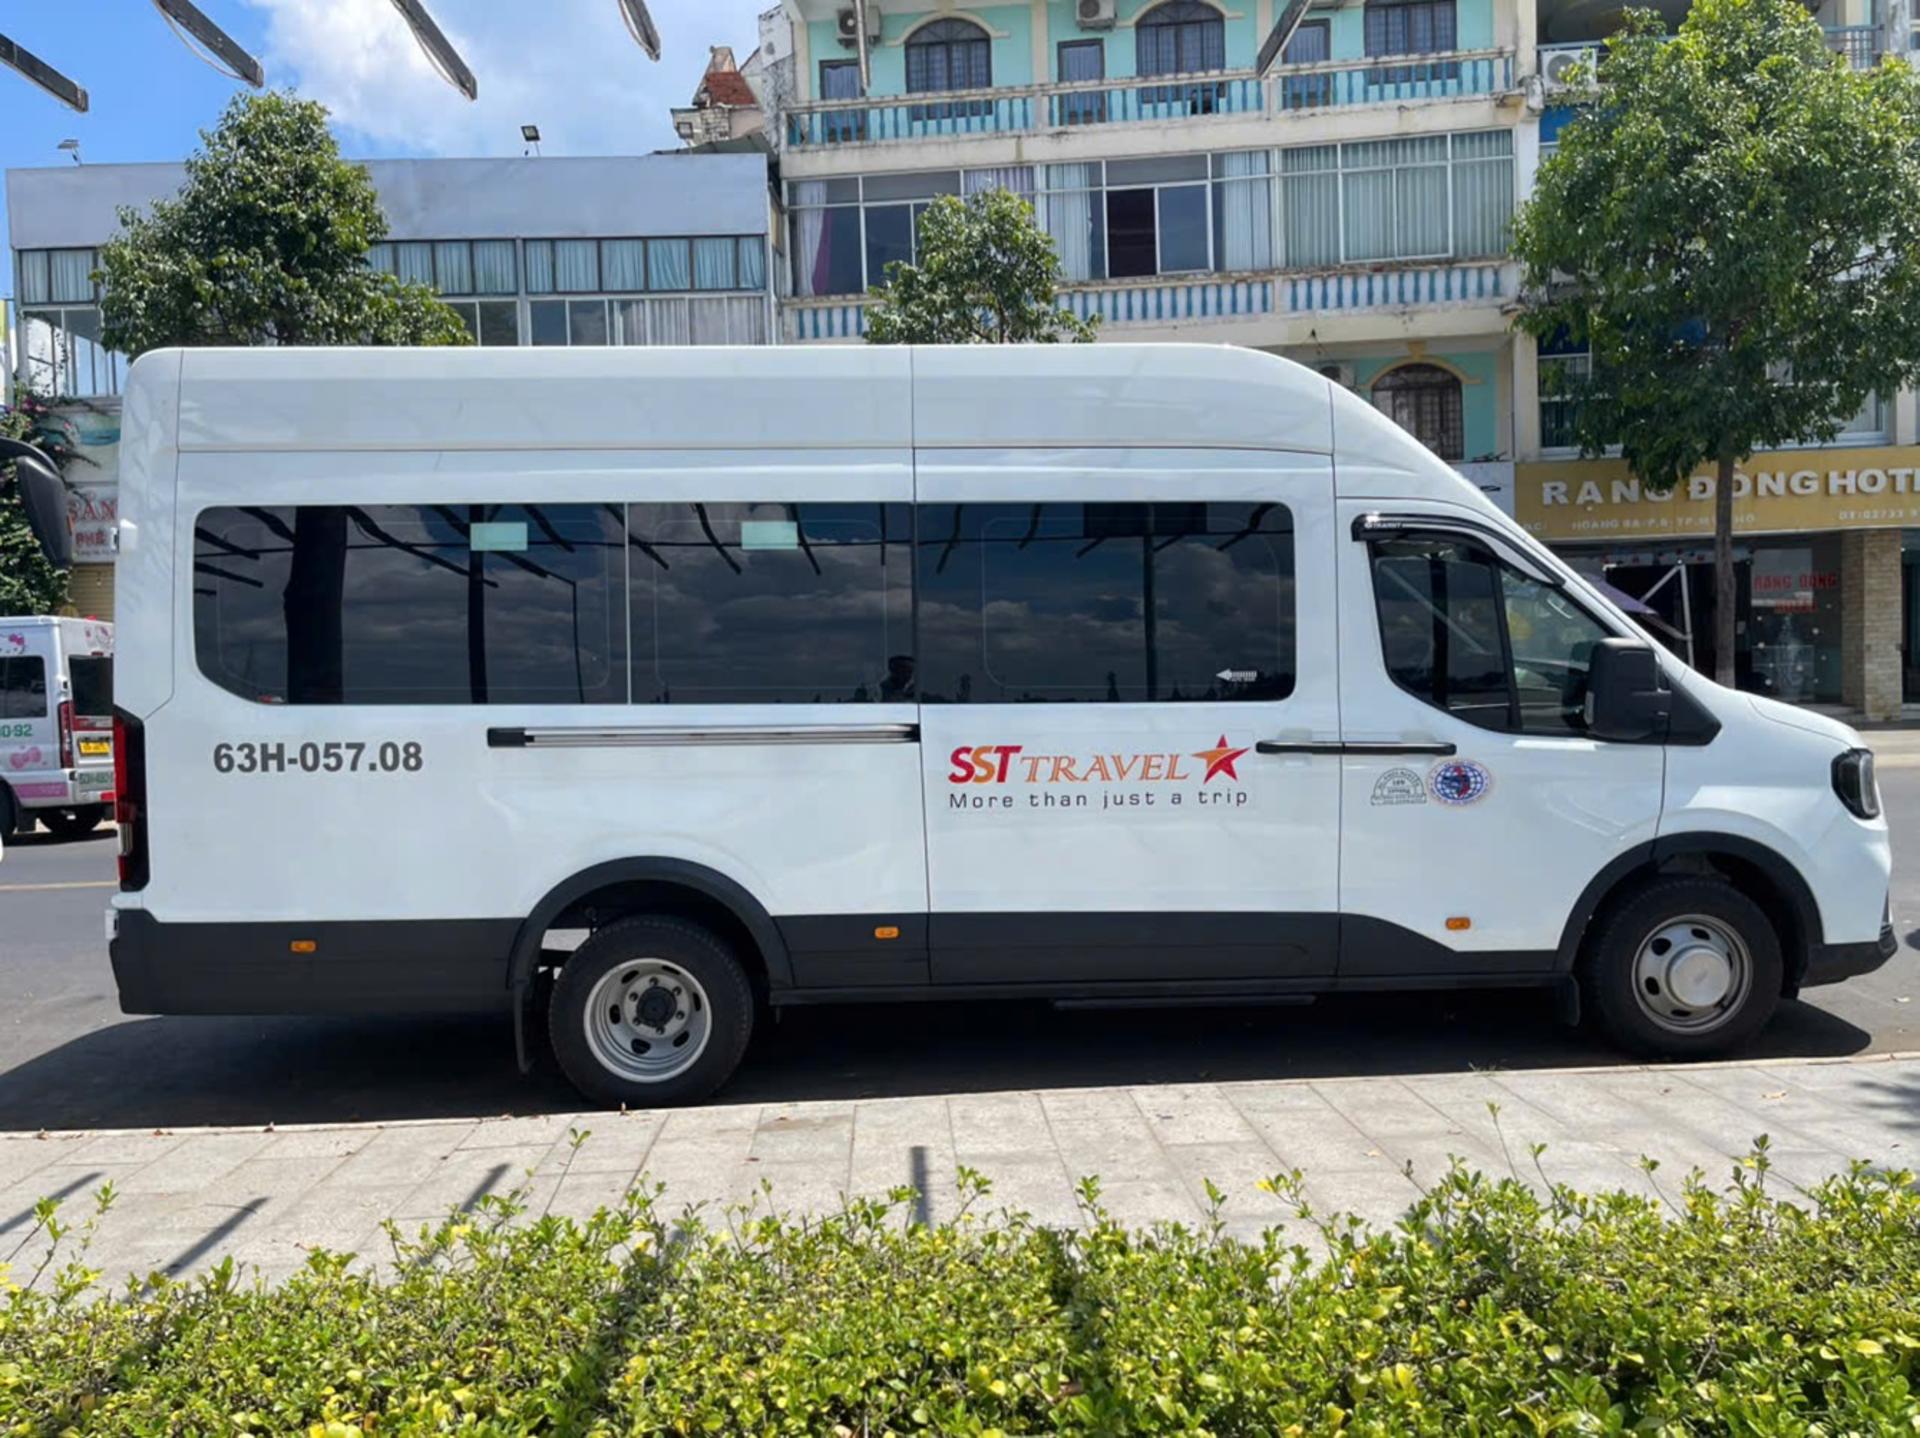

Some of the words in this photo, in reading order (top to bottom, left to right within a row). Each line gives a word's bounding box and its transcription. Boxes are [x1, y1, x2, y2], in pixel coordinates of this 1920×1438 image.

[213, 741, 424, 773] 63H-057.08
[948, 745, 1023, 784] SST
[1018, 754, 1191, 783] TRAVEL
[949, 793, 1014, 809] More
[1029, 792, 1088, 808] than
[1102, 790, 1156, 810] just
[1170, 791, 1183, 805] a
[1198, 788, 1248, 808] trip
